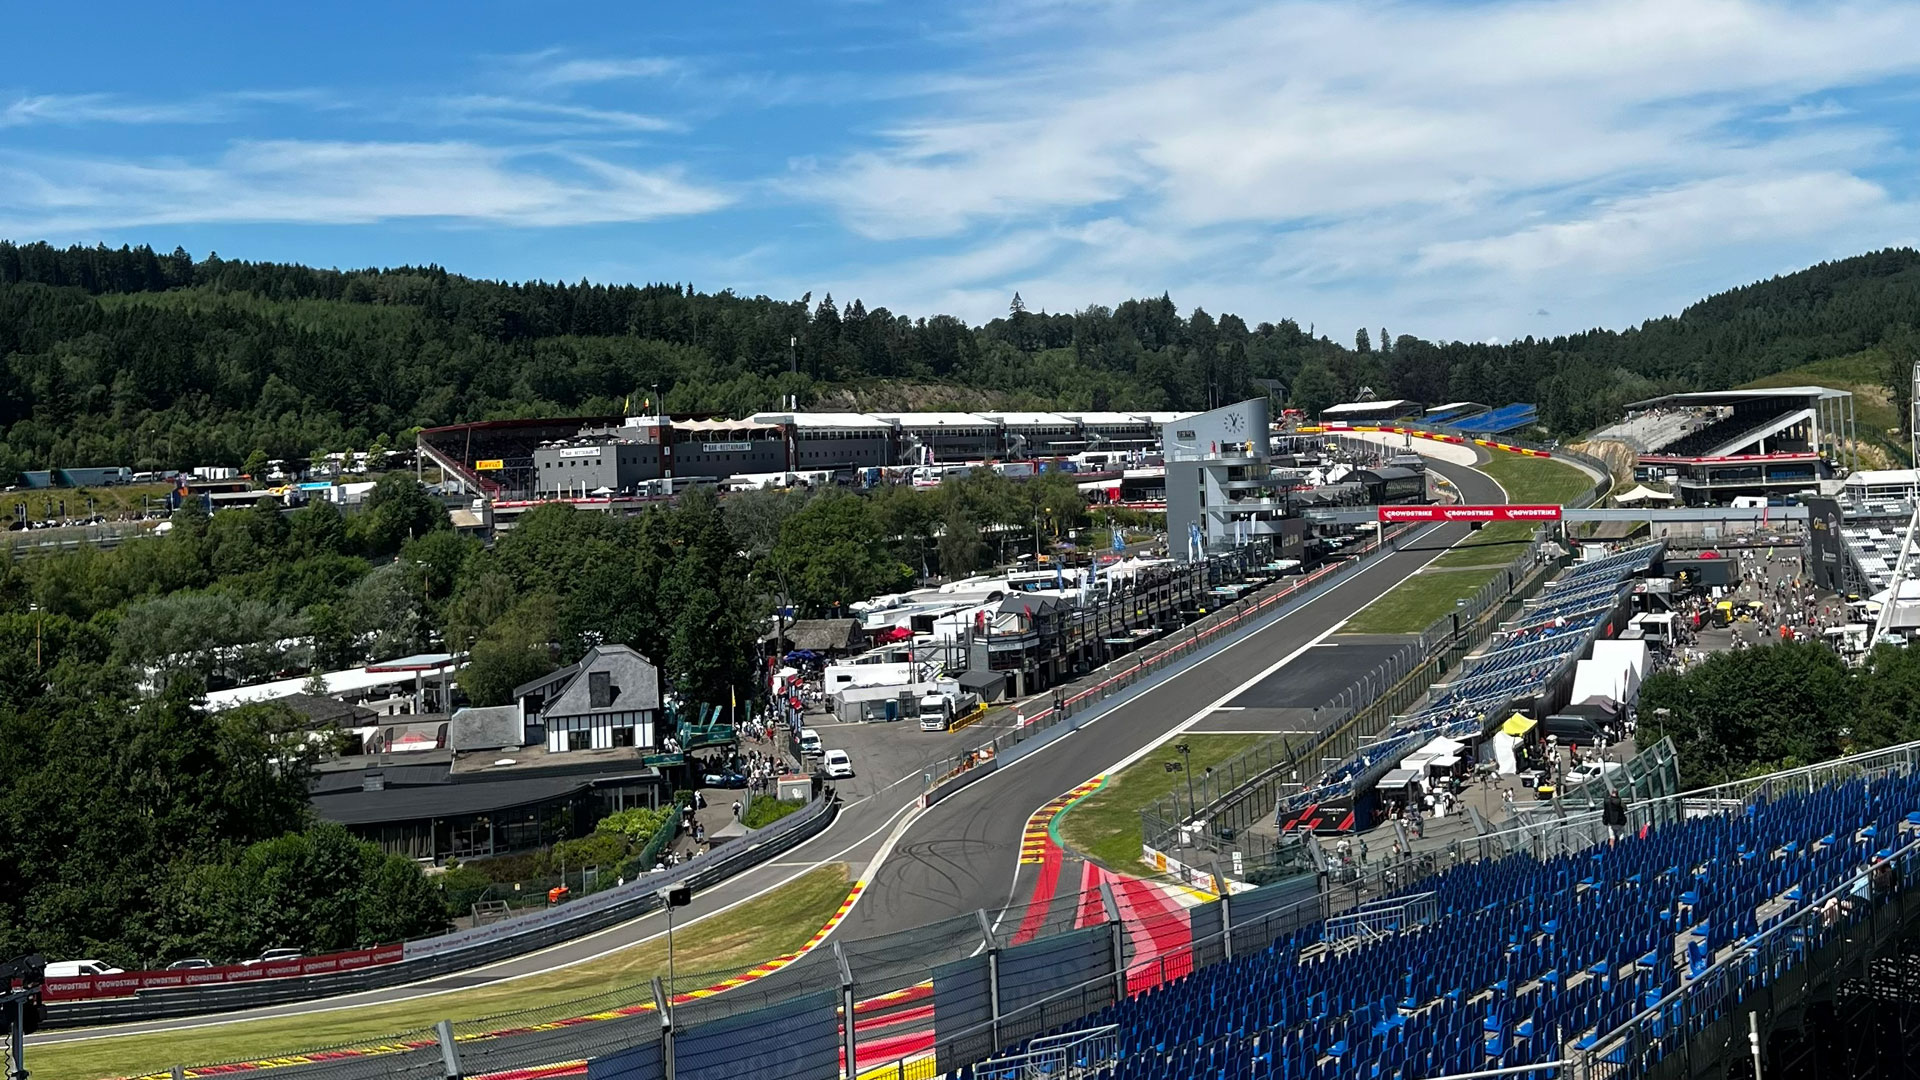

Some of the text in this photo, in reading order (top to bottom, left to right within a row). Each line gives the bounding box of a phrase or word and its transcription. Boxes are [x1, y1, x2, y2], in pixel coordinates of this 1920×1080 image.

[145, 976, 182, 985] CROWDSTRIKE
[187, 973, 224, 982] CROWDSTRIKE
[49, 981, 91, 991] CROWDSTRIKE
[98, 978, 139, 988] CROWDSTRIKE
